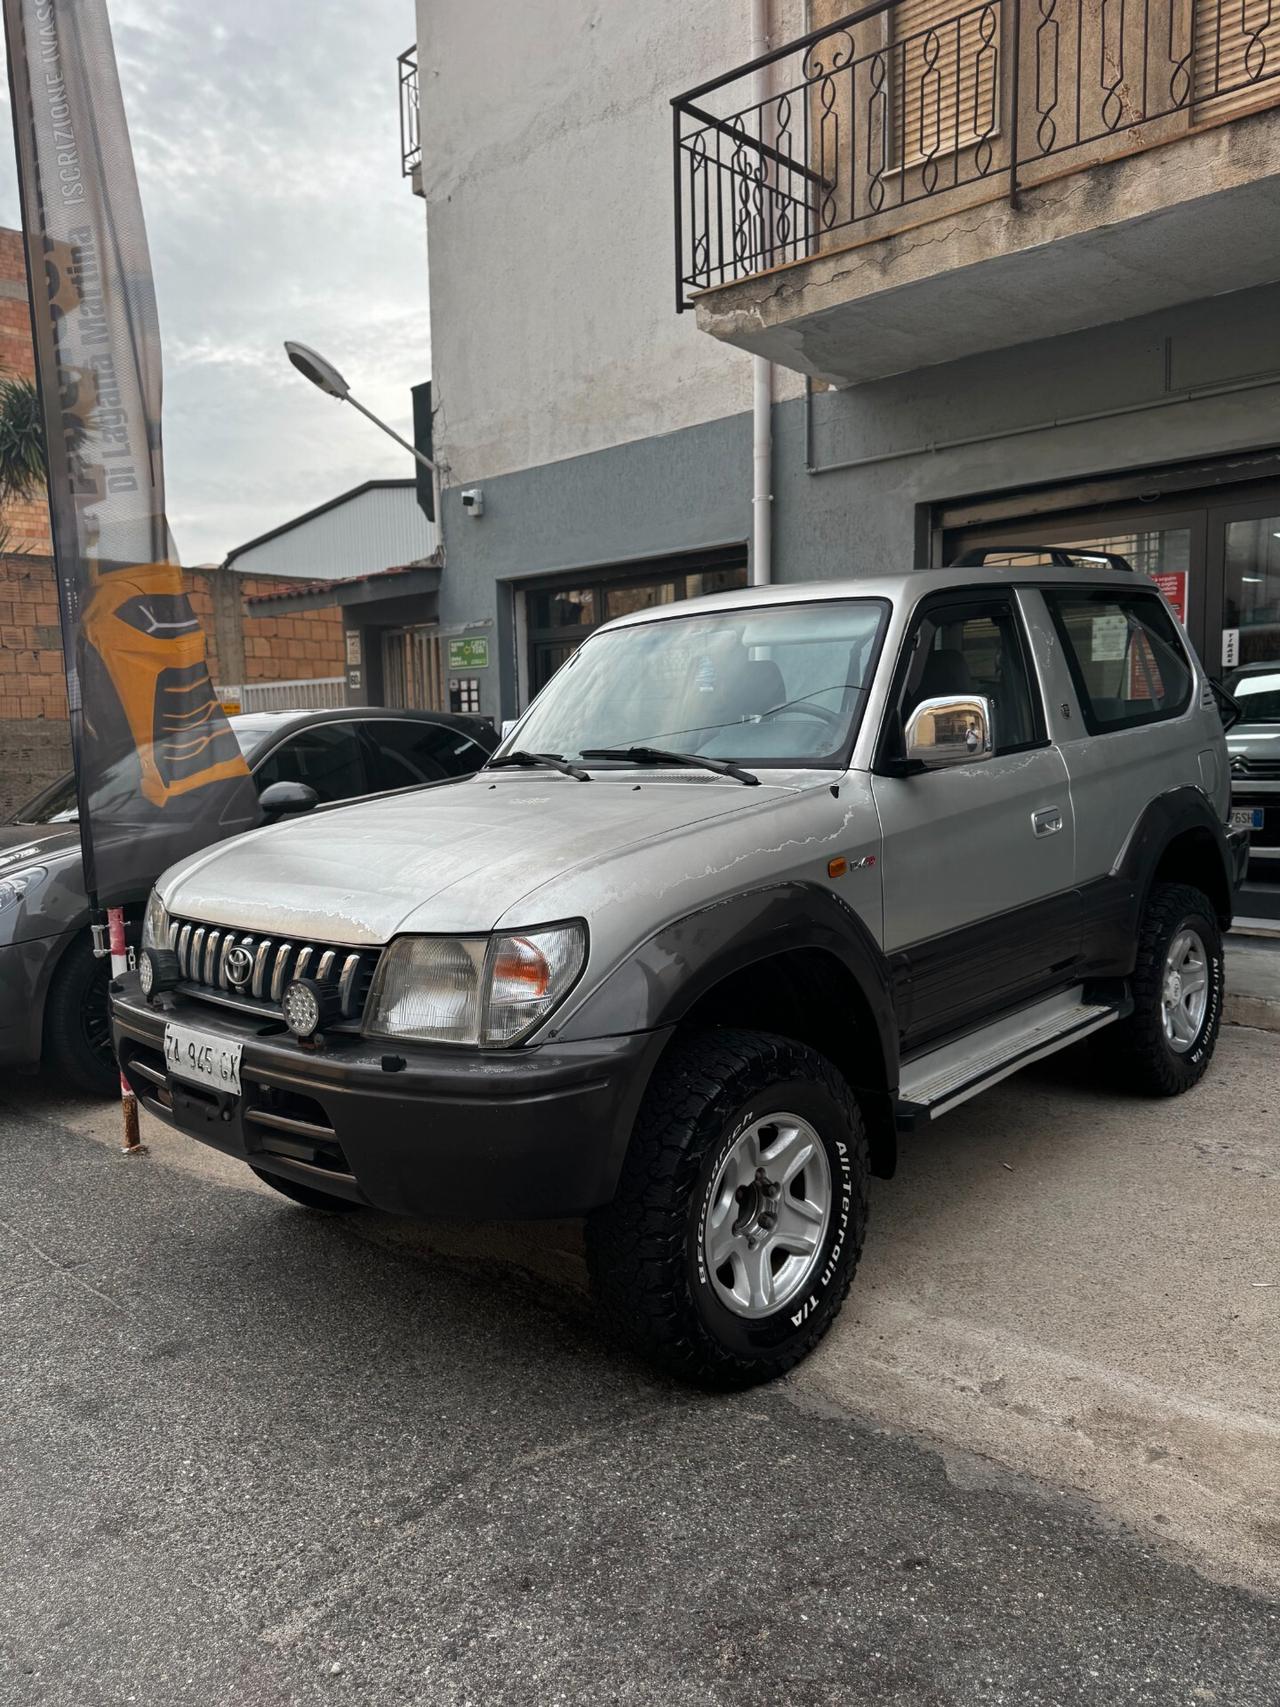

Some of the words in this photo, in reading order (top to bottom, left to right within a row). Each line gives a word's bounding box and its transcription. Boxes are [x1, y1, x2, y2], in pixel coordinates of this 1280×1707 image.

[45, 71, 86, 206] ISCRIZIONE
[66, 225, 110, 346] Martina
[1203, 956, 1220, 1046] All-Terrain
[166, 1034, 181, 1064] ZA
[188, 1041, 213, 1075] 945
[220, 1051, 238, 1085] GX
[1191, 1047, 1204, 1063] T/A
[696, 1111, 753, 1284] BFGoodrich
[820, 1140, 852, 1286] All-Terrain
[790, 1294, 820, 1328] T/A
